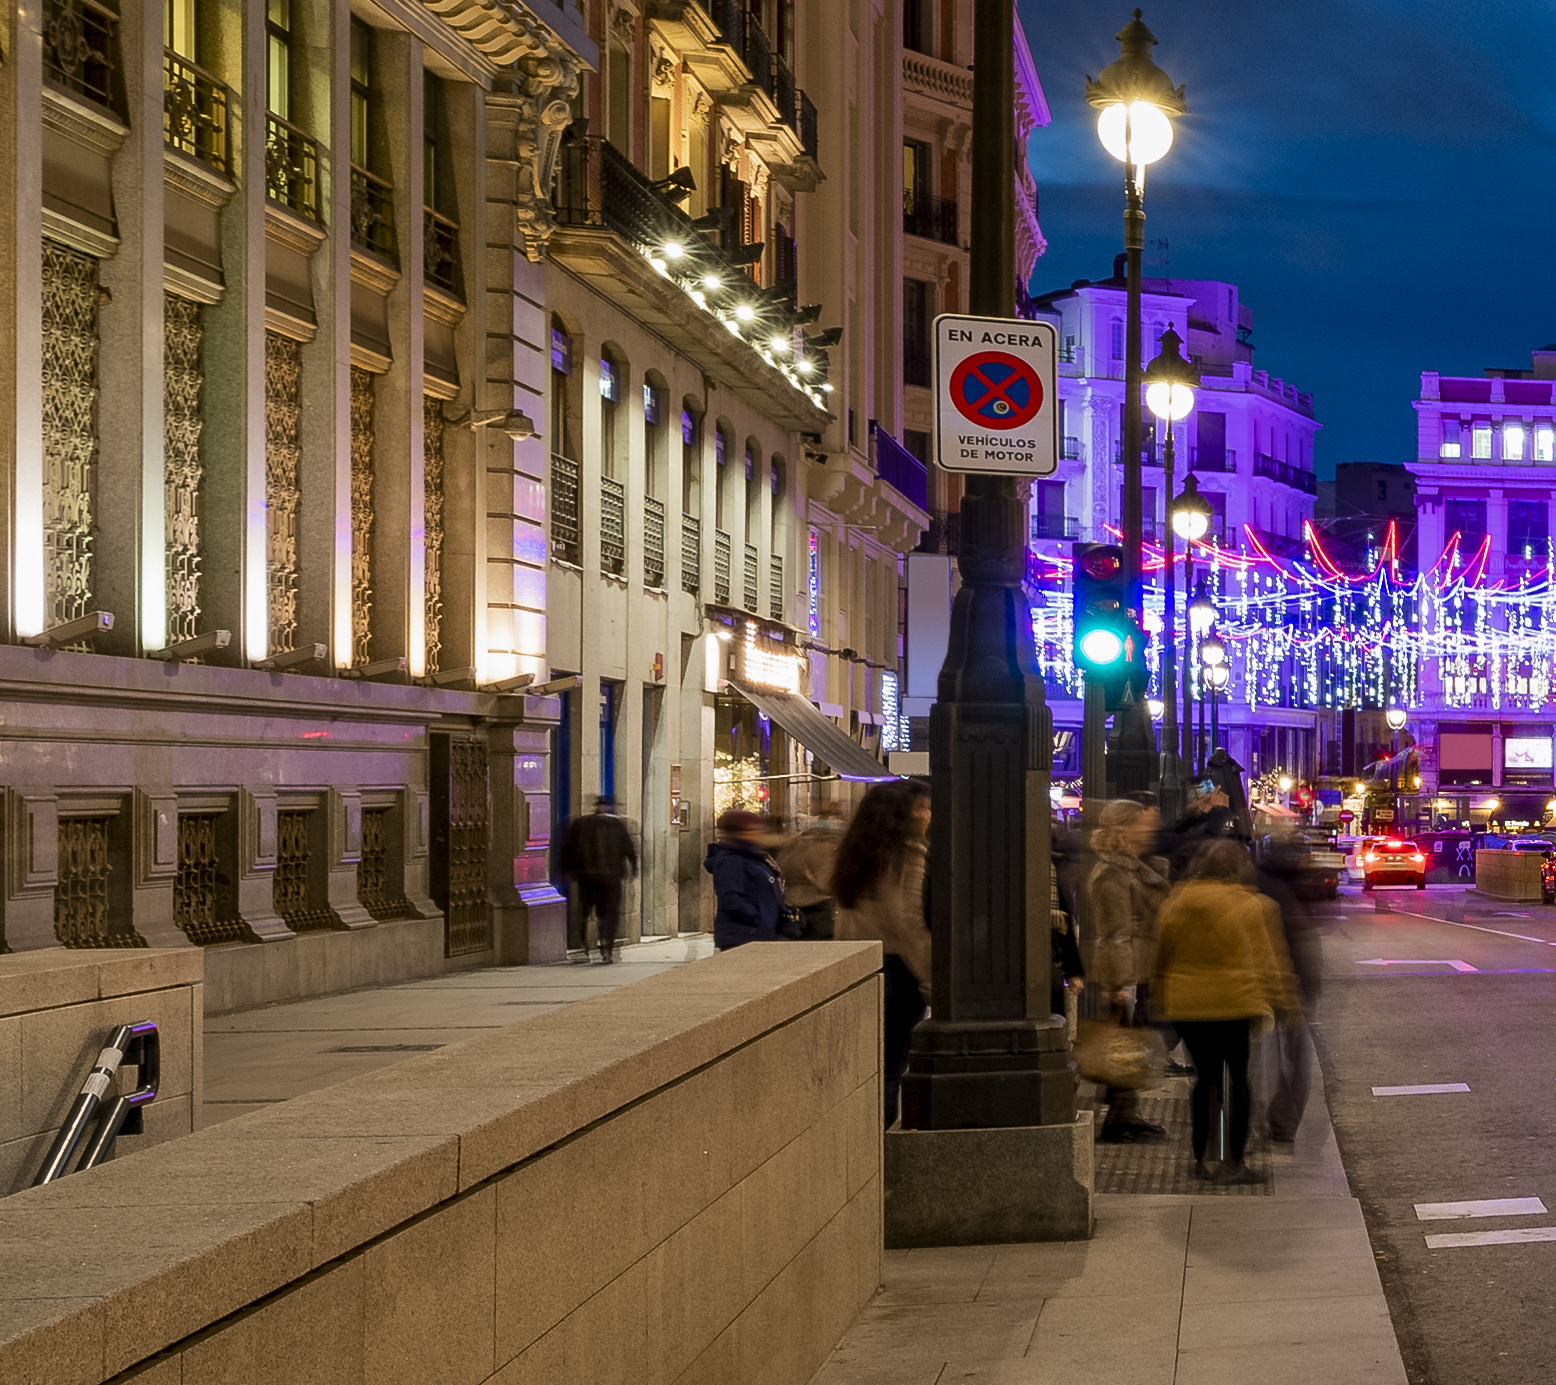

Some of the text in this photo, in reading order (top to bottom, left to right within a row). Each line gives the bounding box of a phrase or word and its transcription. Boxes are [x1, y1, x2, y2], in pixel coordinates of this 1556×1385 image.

[948, 329, 1043, 348] EN ACERA
[958, 434, 1037, 449] VEHÍCULOS
[960, 448, 1034, 462] DE MOTOR
